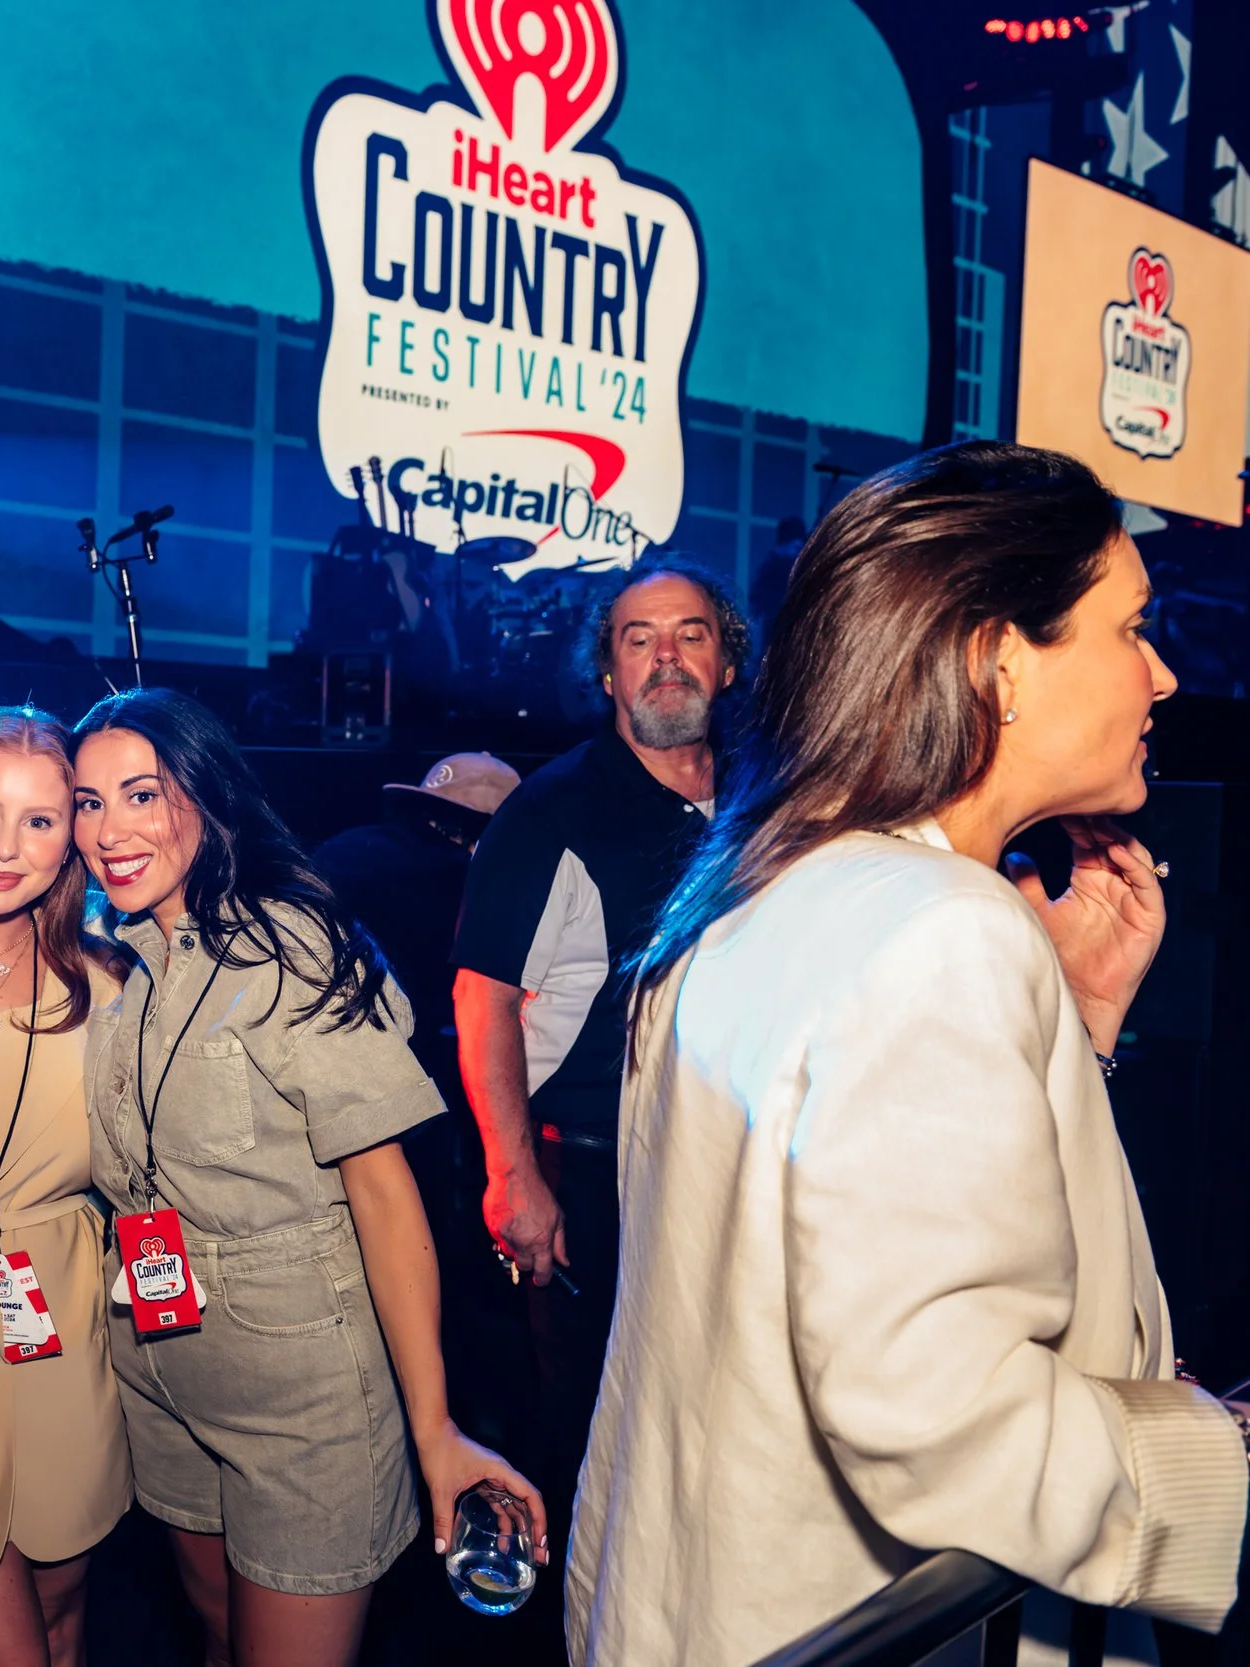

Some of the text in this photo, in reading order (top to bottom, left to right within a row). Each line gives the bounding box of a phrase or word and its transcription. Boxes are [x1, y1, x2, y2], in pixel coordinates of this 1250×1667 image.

[452, 128, 596, 228] iHeart
[362, 131, 665, 363] COUNTRY
[366, 312, 586, 412] FESTIVAL
[361, 385, 450, 411] PRESENTED BY
[136, 1257, 177, 1278] COUNTRY
[146, 1256, 166, 1264] iHeart
[161, 1315, 172, 1323] 397
[20, 1345, 34, 1355] 397
